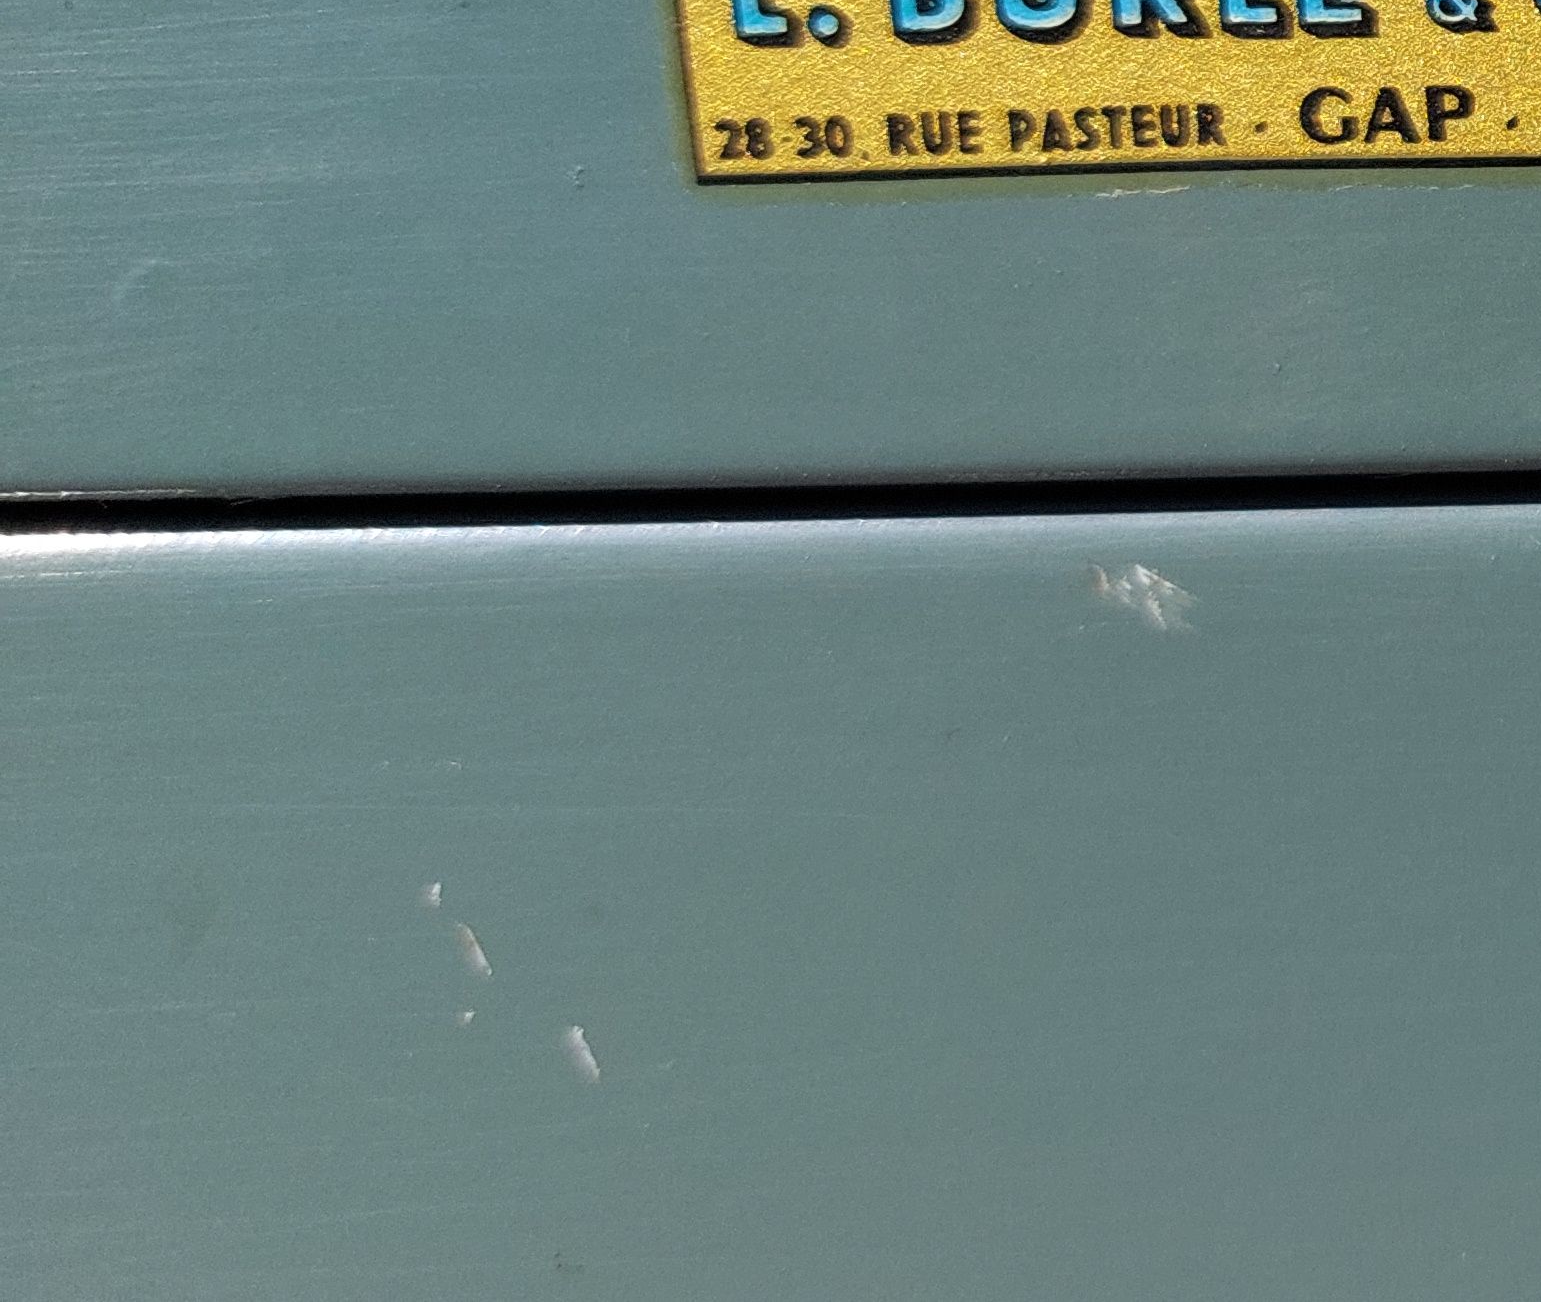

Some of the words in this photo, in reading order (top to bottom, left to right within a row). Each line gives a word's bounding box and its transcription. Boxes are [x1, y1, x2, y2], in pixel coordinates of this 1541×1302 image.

[886, 109, 984, 157] RUE
[1008, 102, 1229, 154] PASTEUR
[1299, 85, 1476, 145] GAP
